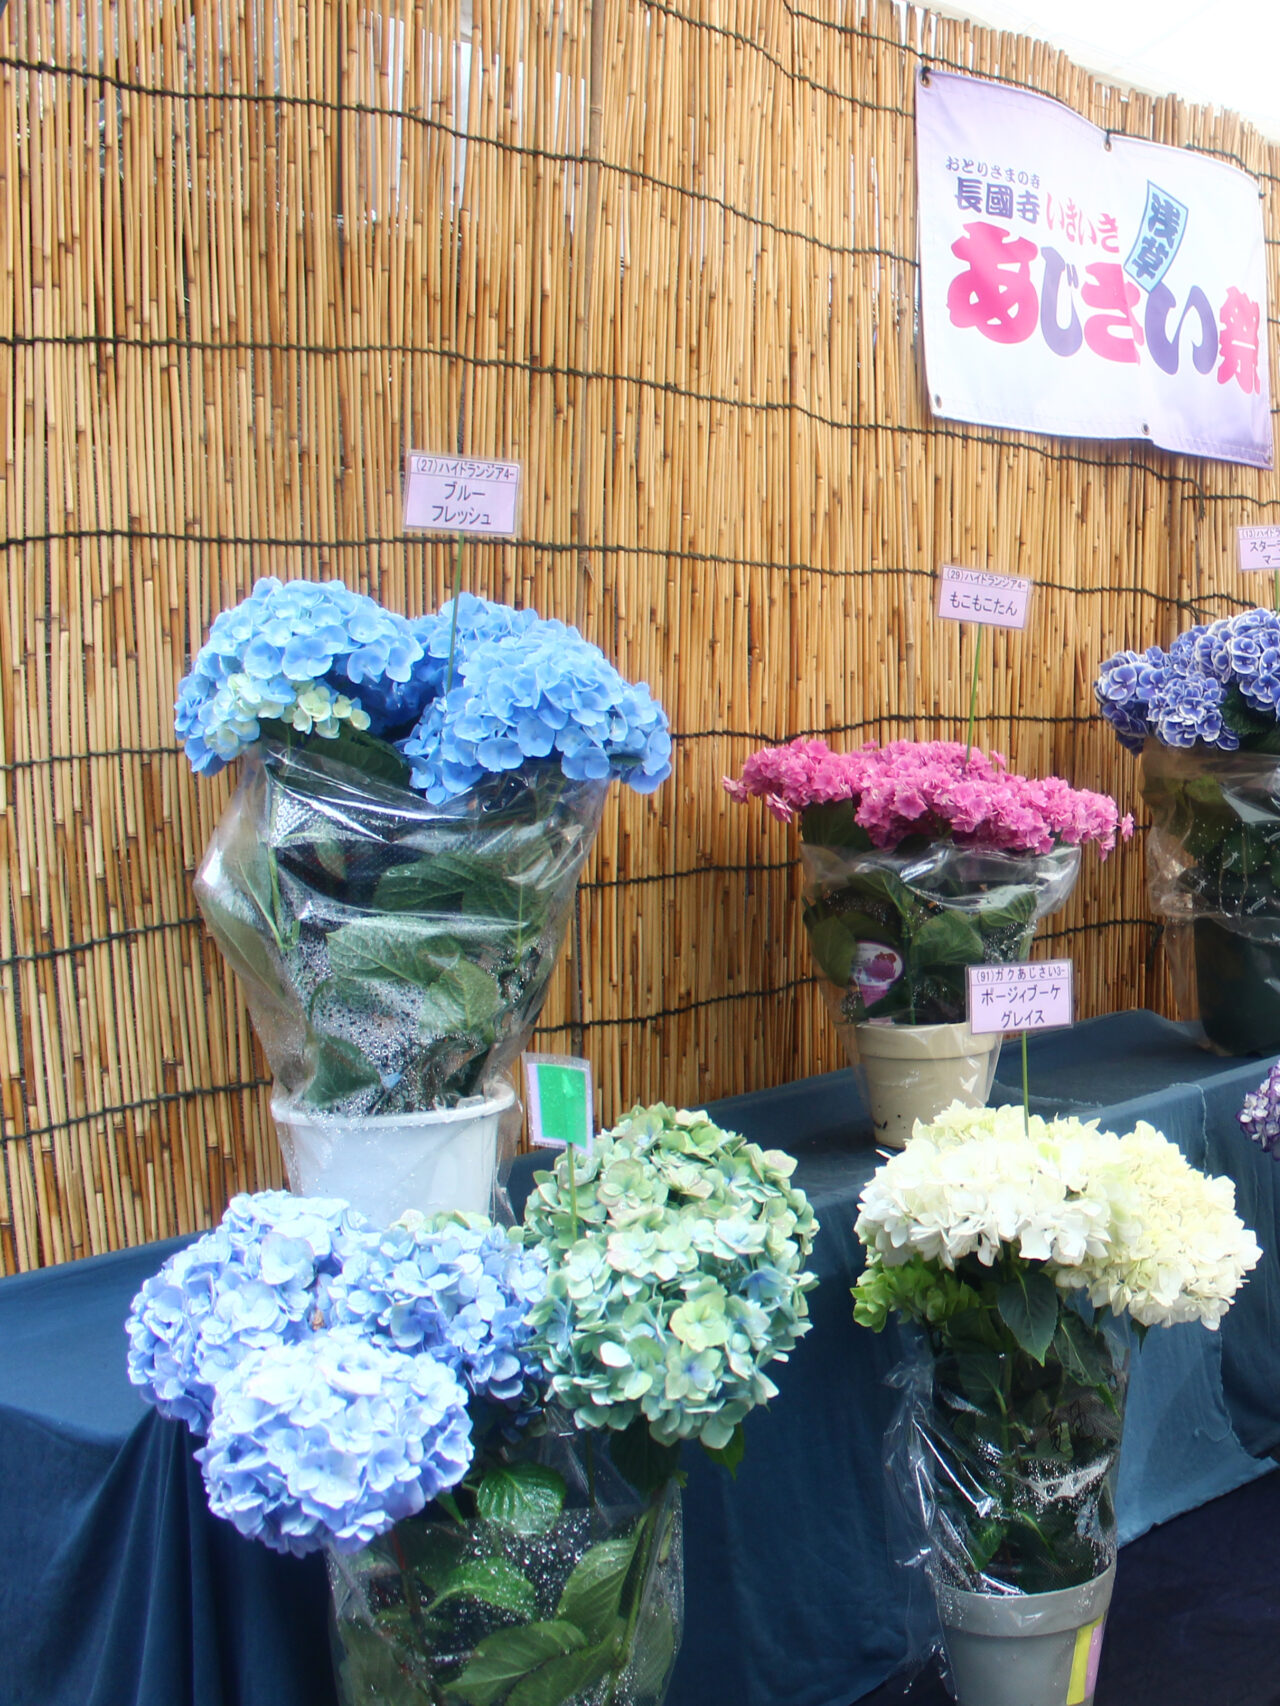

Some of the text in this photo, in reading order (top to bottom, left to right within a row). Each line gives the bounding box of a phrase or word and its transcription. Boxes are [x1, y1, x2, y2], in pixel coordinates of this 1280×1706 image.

[945, 156, 1040, 189] おとりさまの寺
[954, 176, 1040, 224] 長國寺
[946, 221, 1260, 395] あじさい祭
[444, 481, 486, 501] ブルー
[432, 505, 491, 525] フレッシュ
[949, 591, 1018, 616] もこもこたん
[1001, 1009, 1045, 1028] グレイス
